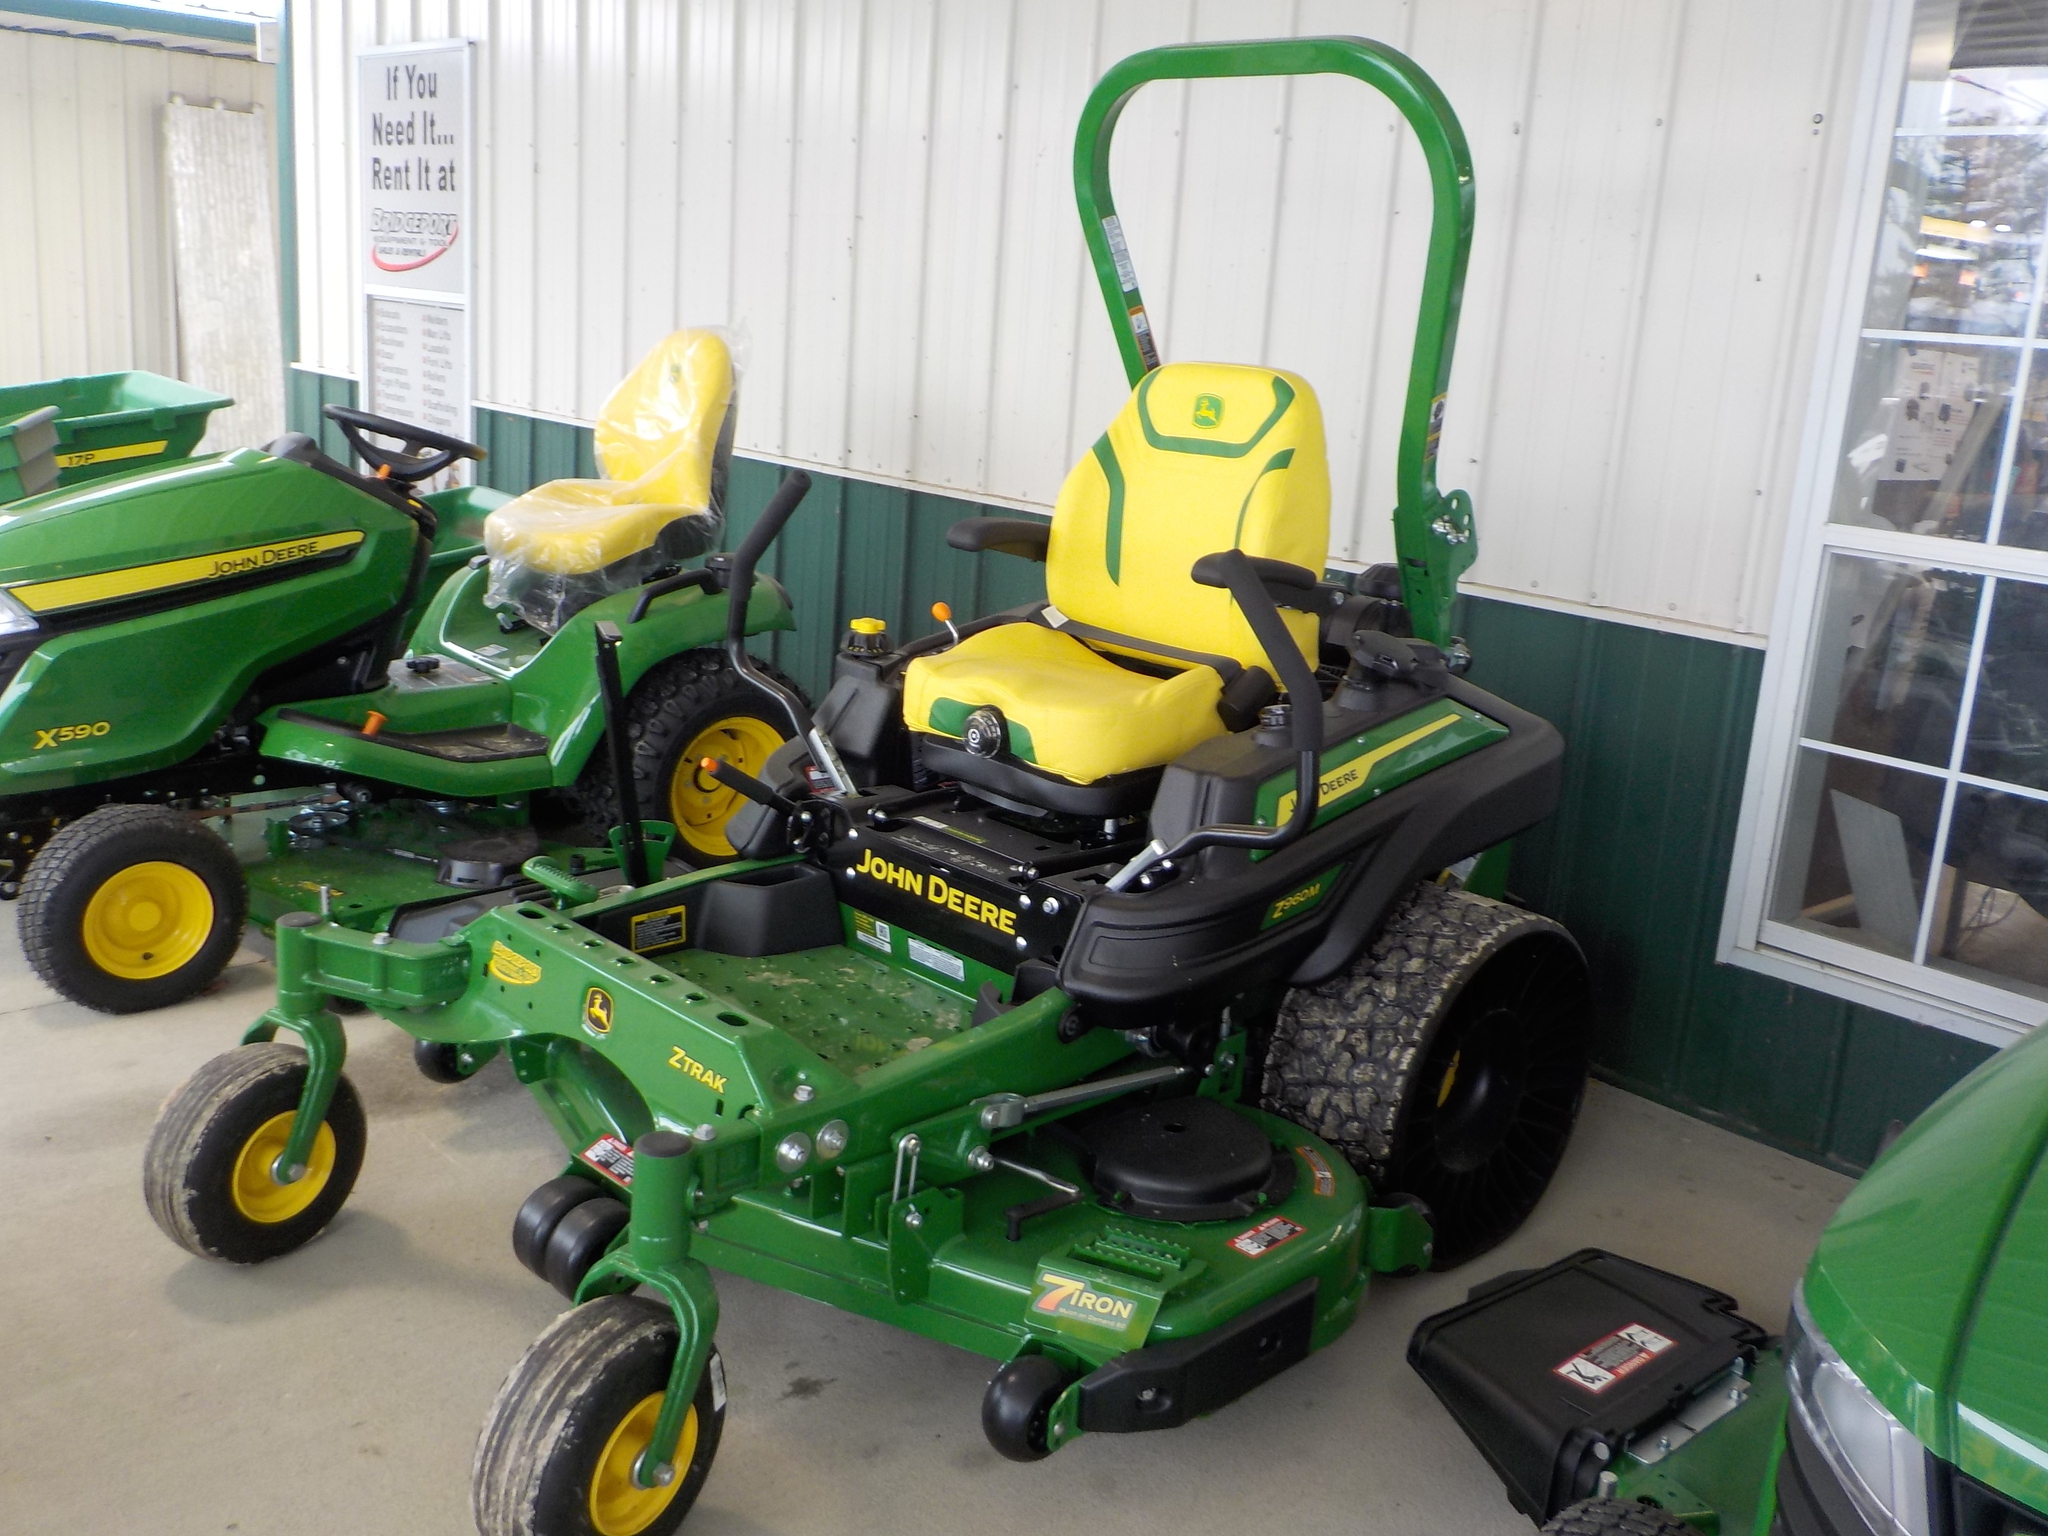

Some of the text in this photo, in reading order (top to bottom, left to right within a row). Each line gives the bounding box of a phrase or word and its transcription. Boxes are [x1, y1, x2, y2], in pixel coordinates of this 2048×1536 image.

[387, 64, 438, 100] If You
[372, 110, 455, 146] Need It...
[372, 156, 456, 191] Rent It at
[370, 207, 457, 237] BRIDGEPORT
[68, 453, 96, 467] 17P
[208, 540, 319, 577] JOHN DEERE
[33, 721, 111, 750] X590
[1320, 768, 1359, 796] DEERE
[856, 848, 923, 896] JOHN
[927, 874, 1018, 936] DEERE
[1271, 883, 1321, 919] Z960M
[668, 1045, 729, 1095] ZTRAK
[1037, 1273, 1134, 1320] 7 IRON
